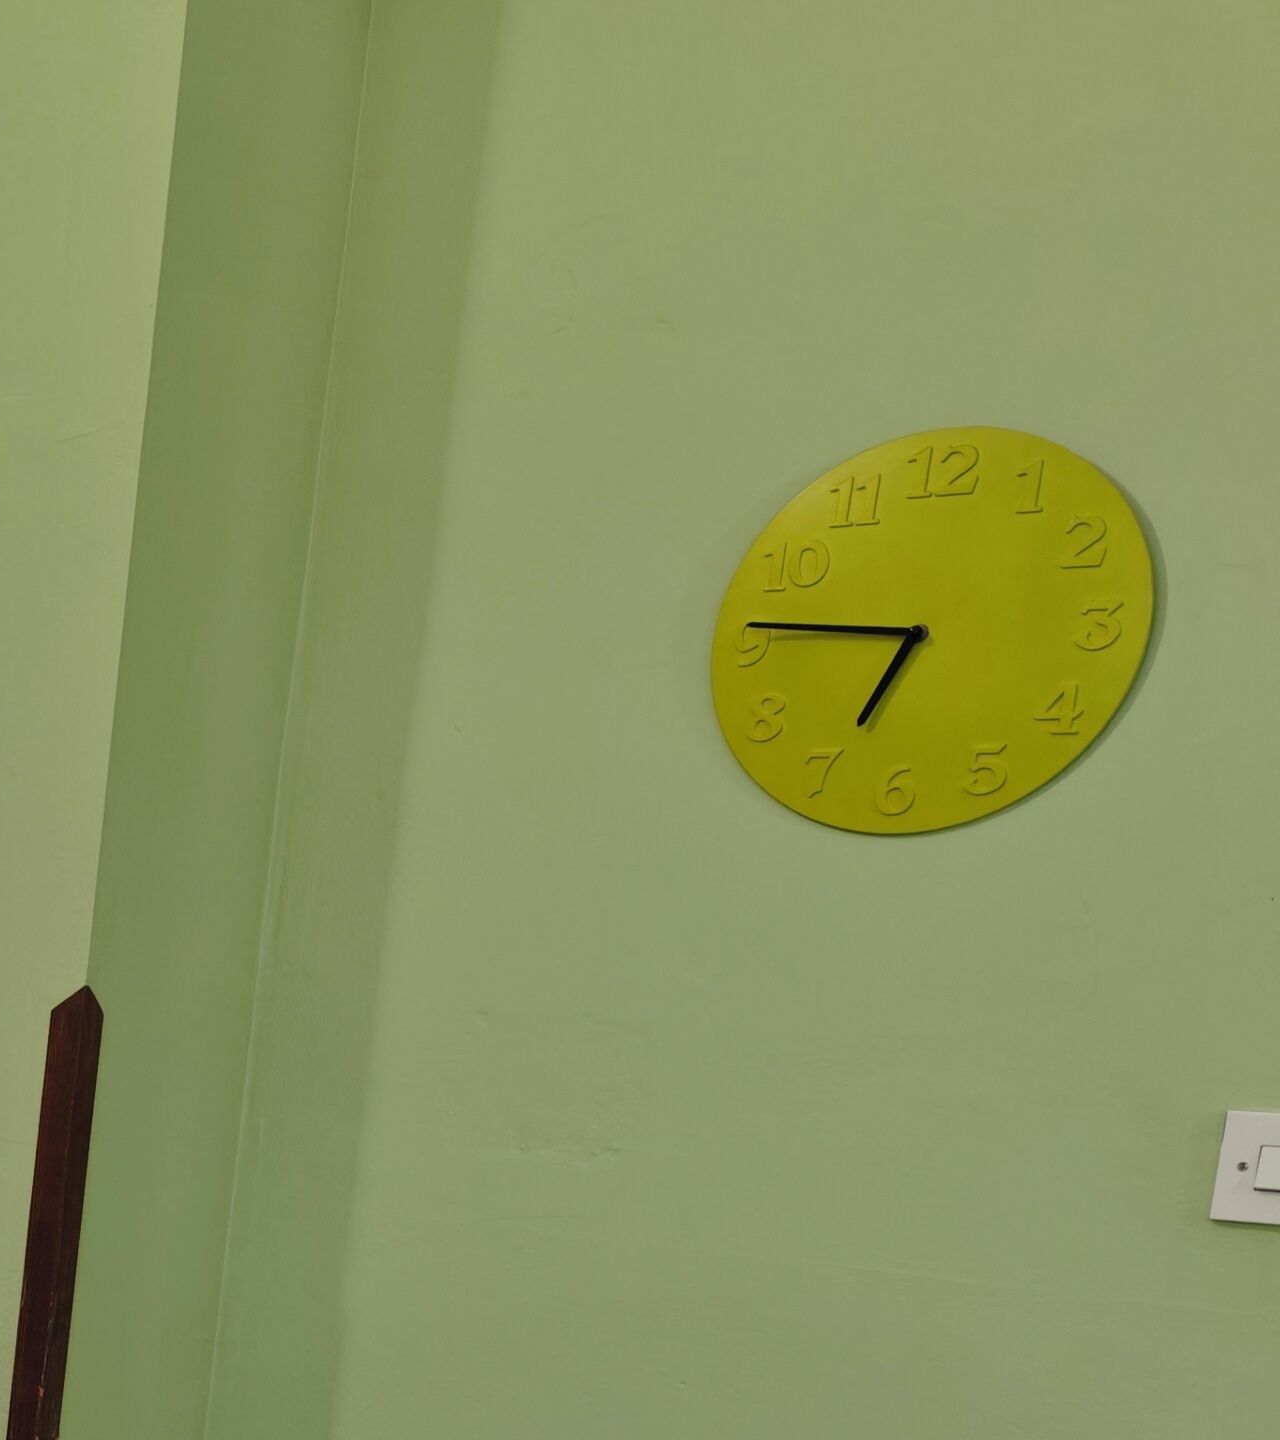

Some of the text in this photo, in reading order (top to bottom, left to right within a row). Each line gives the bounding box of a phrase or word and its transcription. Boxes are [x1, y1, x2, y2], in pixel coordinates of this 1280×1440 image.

[906, 443, 980, 499] 12
[1015, 459, 1045, 514] 1
[828, 473, 881, 528] 11
[762, 540, 831, 593] 10
[1059, 515, 1108, 570] 2
[735, 618, 772, 668] 9
[1073, 600, 1124, 652] 3
[745, 692, 787, 743] 8
[1033, 683, 1085, 736] 4
[804, 745, 845, 800] 7
[876, 766, 916, 817] 6
[964, 743, 1009, 796] 5
